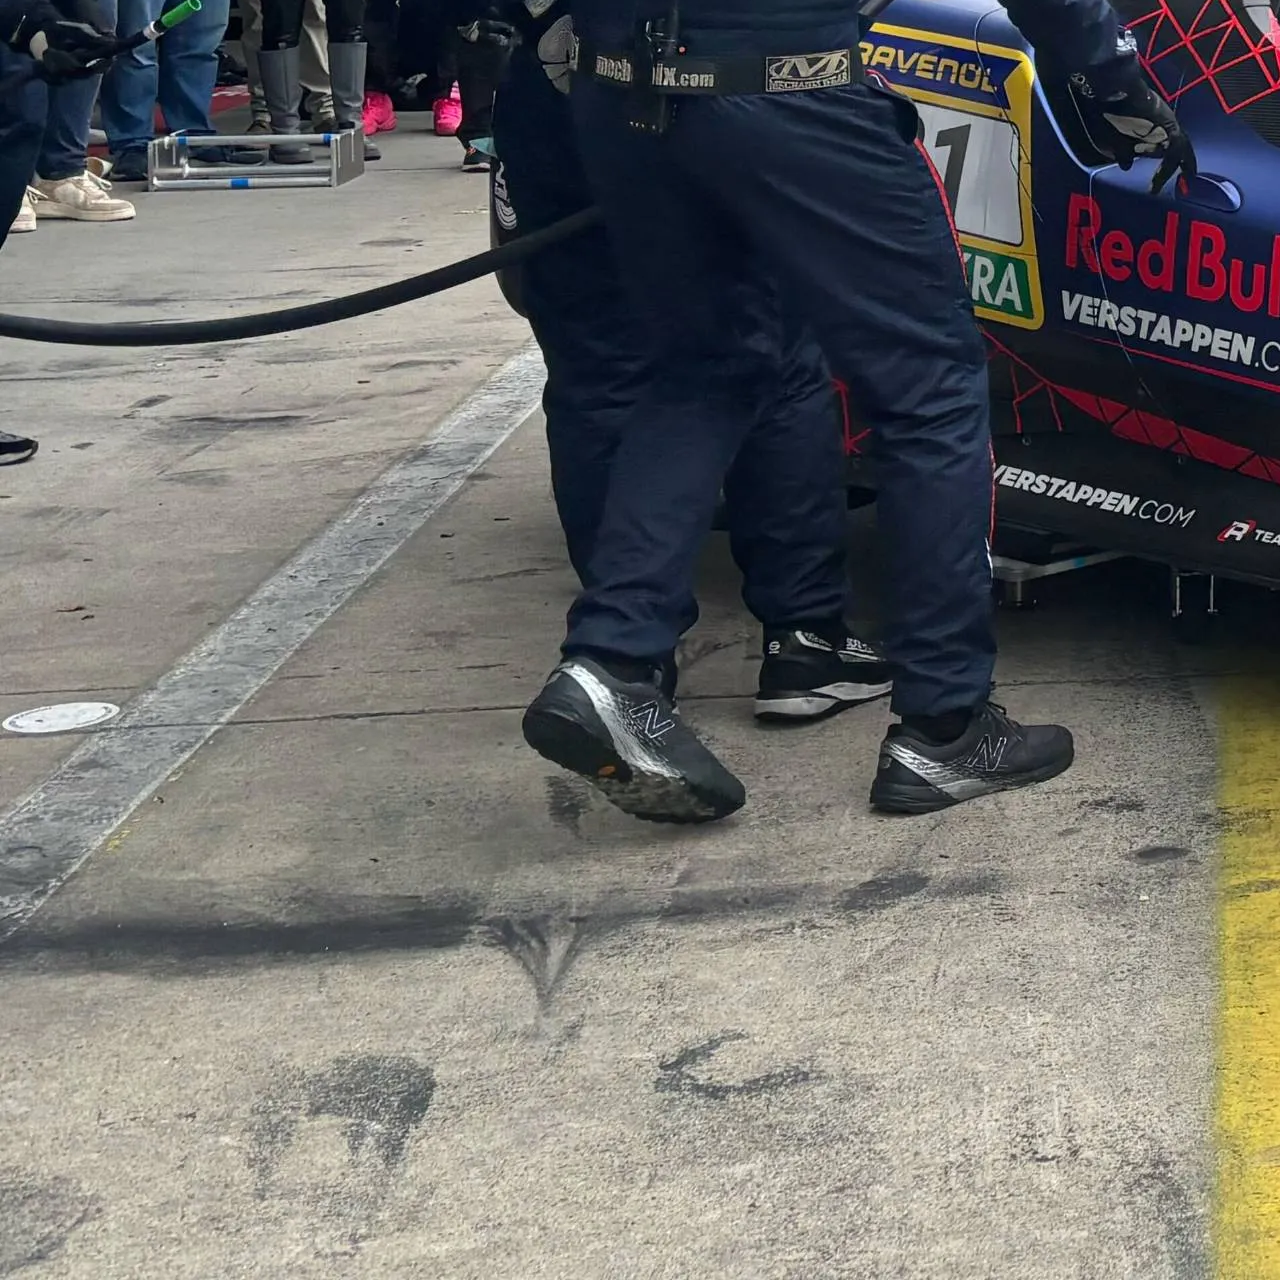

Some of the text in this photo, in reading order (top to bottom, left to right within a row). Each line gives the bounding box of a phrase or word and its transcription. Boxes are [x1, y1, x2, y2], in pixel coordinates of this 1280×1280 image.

[857, 40, 998, 94] RAVENOL
[1064, 193, 1181, 292] Red
[992, 463, 1197, 529] VERSTAPPEN.COM
